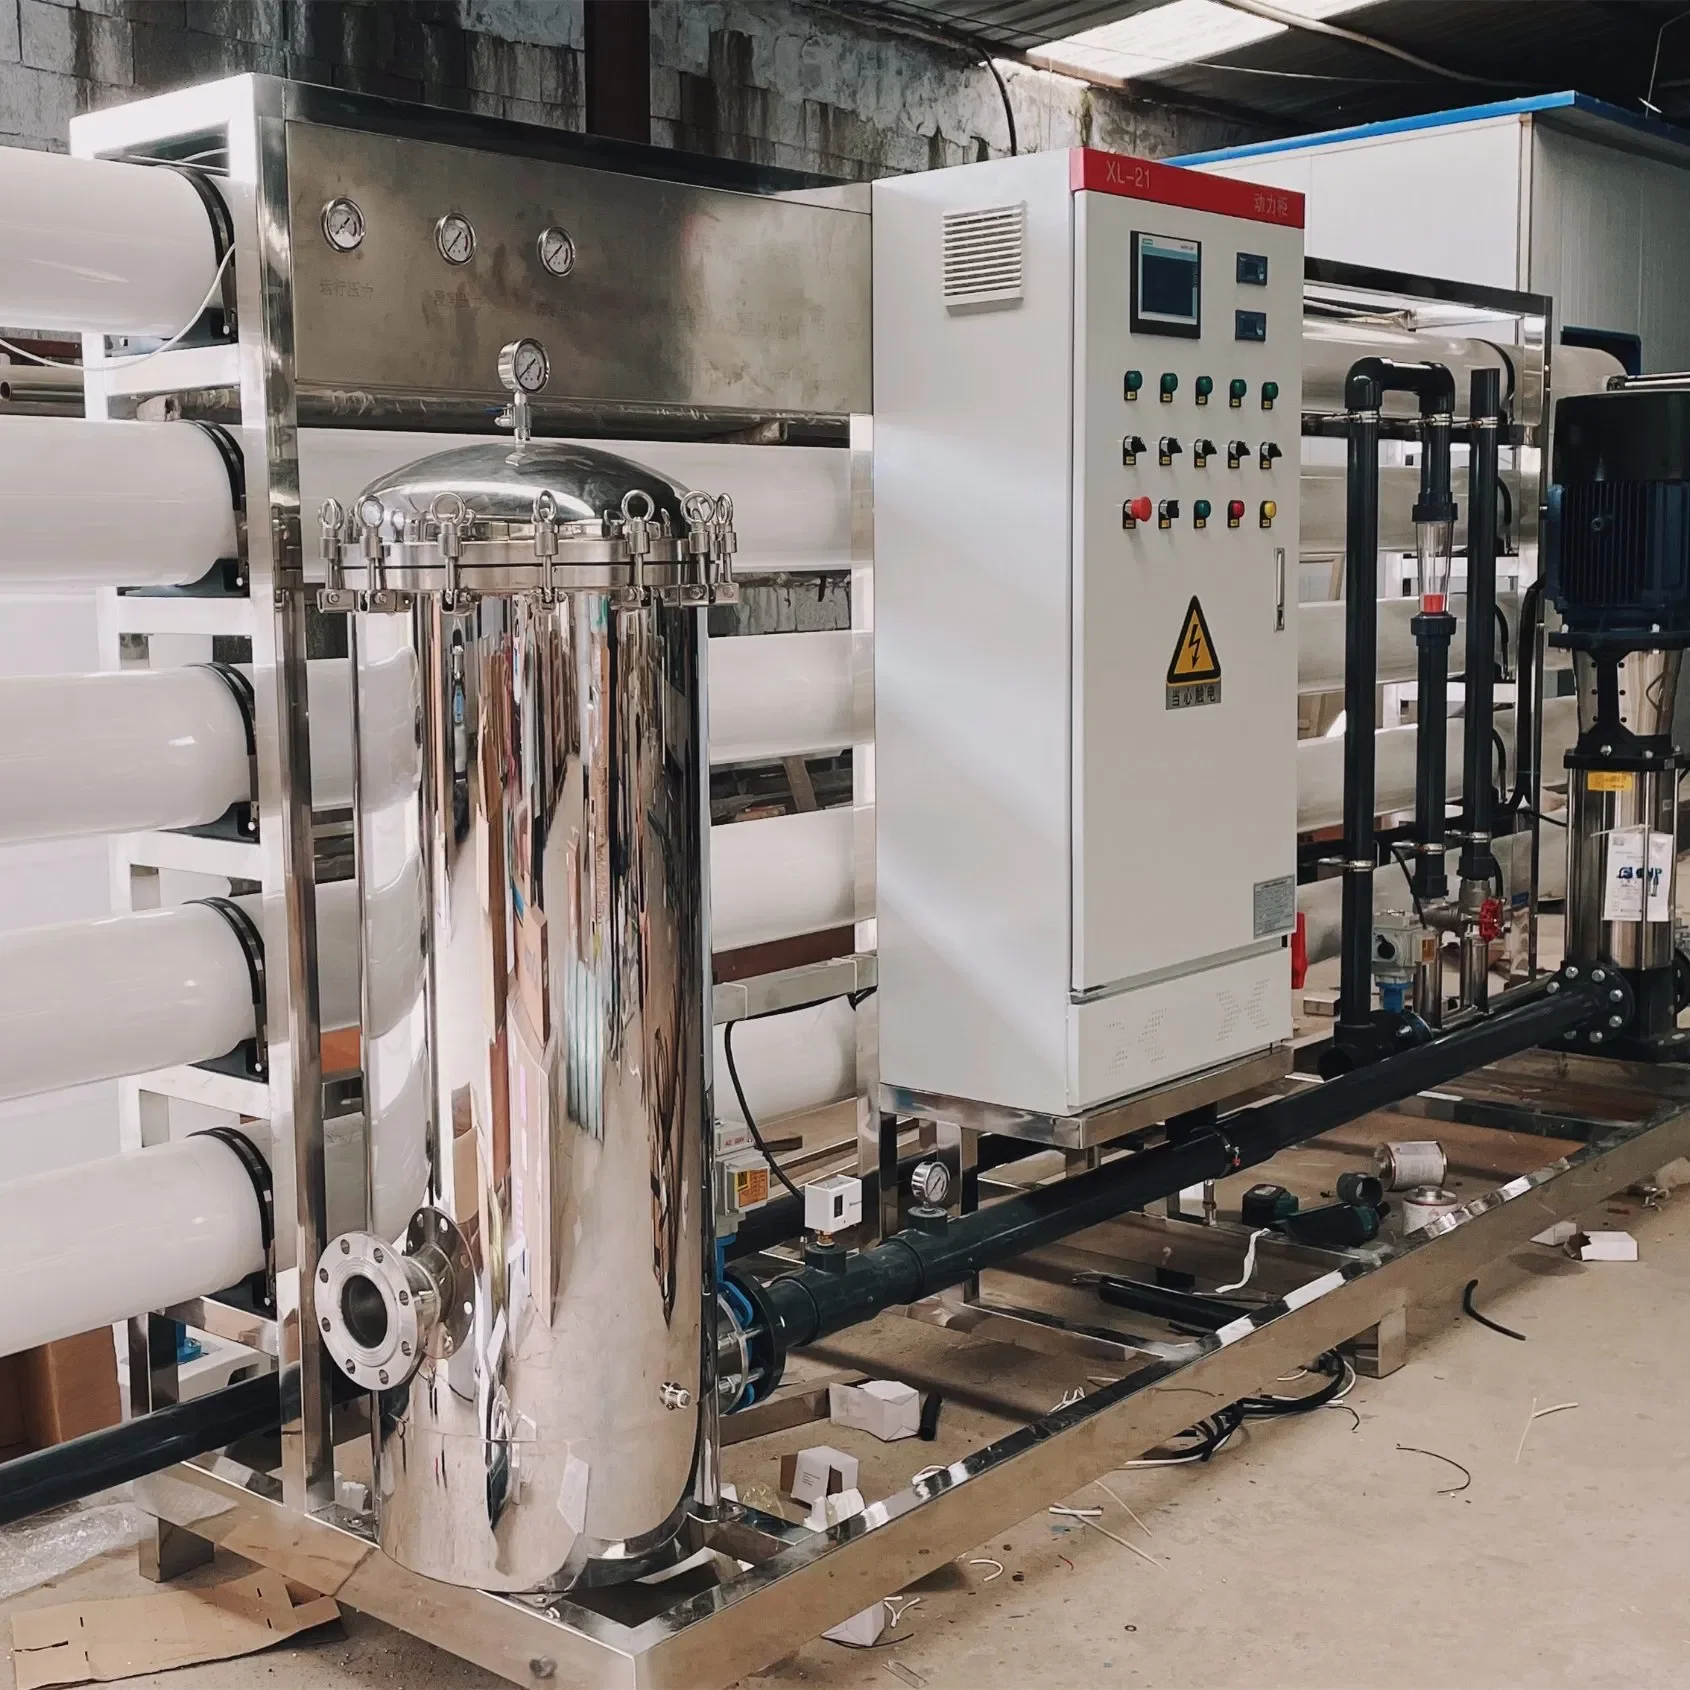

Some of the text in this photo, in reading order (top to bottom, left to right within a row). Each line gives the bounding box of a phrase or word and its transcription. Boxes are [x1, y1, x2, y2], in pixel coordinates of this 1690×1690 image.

[1106, 160, 1150, 189] XL-21
[1172, 685, 1216, 706] 当心触电
